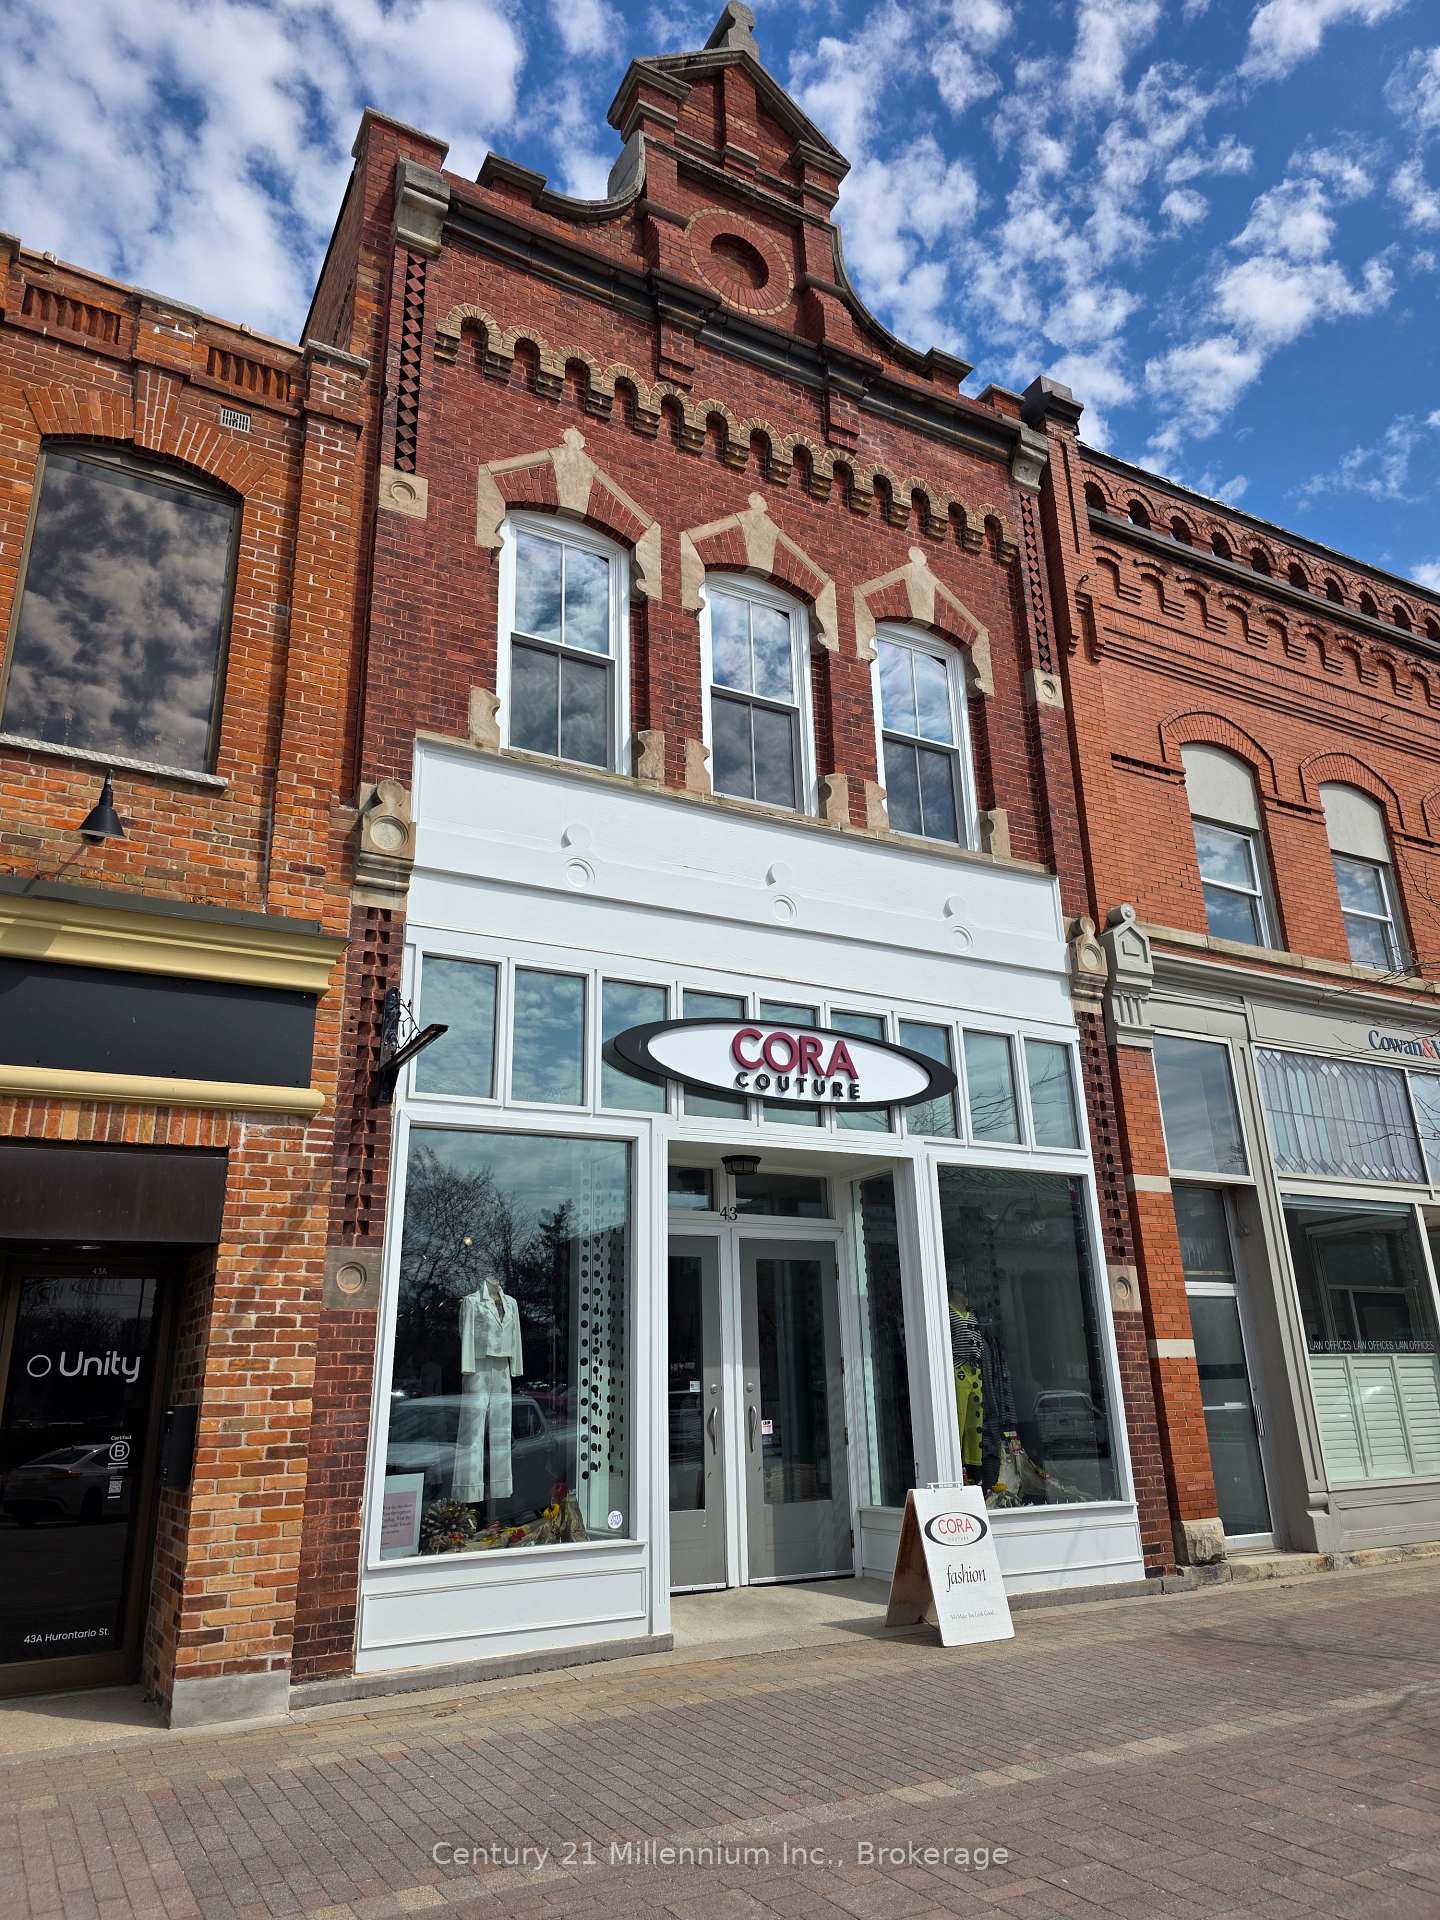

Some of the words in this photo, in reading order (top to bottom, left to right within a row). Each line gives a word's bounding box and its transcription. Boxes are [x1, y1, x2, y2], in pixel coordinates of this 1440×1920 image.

[731, 1027, 860, 1080] CORA
[735, 1071, 861, 1100] COUTURE
[719, 1206, 738, 1222] 43
[1309, 1340, 1323, 1350] LAW
[1325, 1340, 1352, 1351] OFFICES
[1354, 1340, 1366, 1350] LAW
[1368, 1340, 1393, 1351] OFFICES
[1409, 1340, 1434, 1351] OFFICES
[60, 1351, 140, 1383] Unity
[938, 1517, 974, 1535] CORA
[946, 1563, 987, 1593] fashion
[23, 1634, 42, 1644] 43A
[45, 1629, 97, 1642] Hurontario
